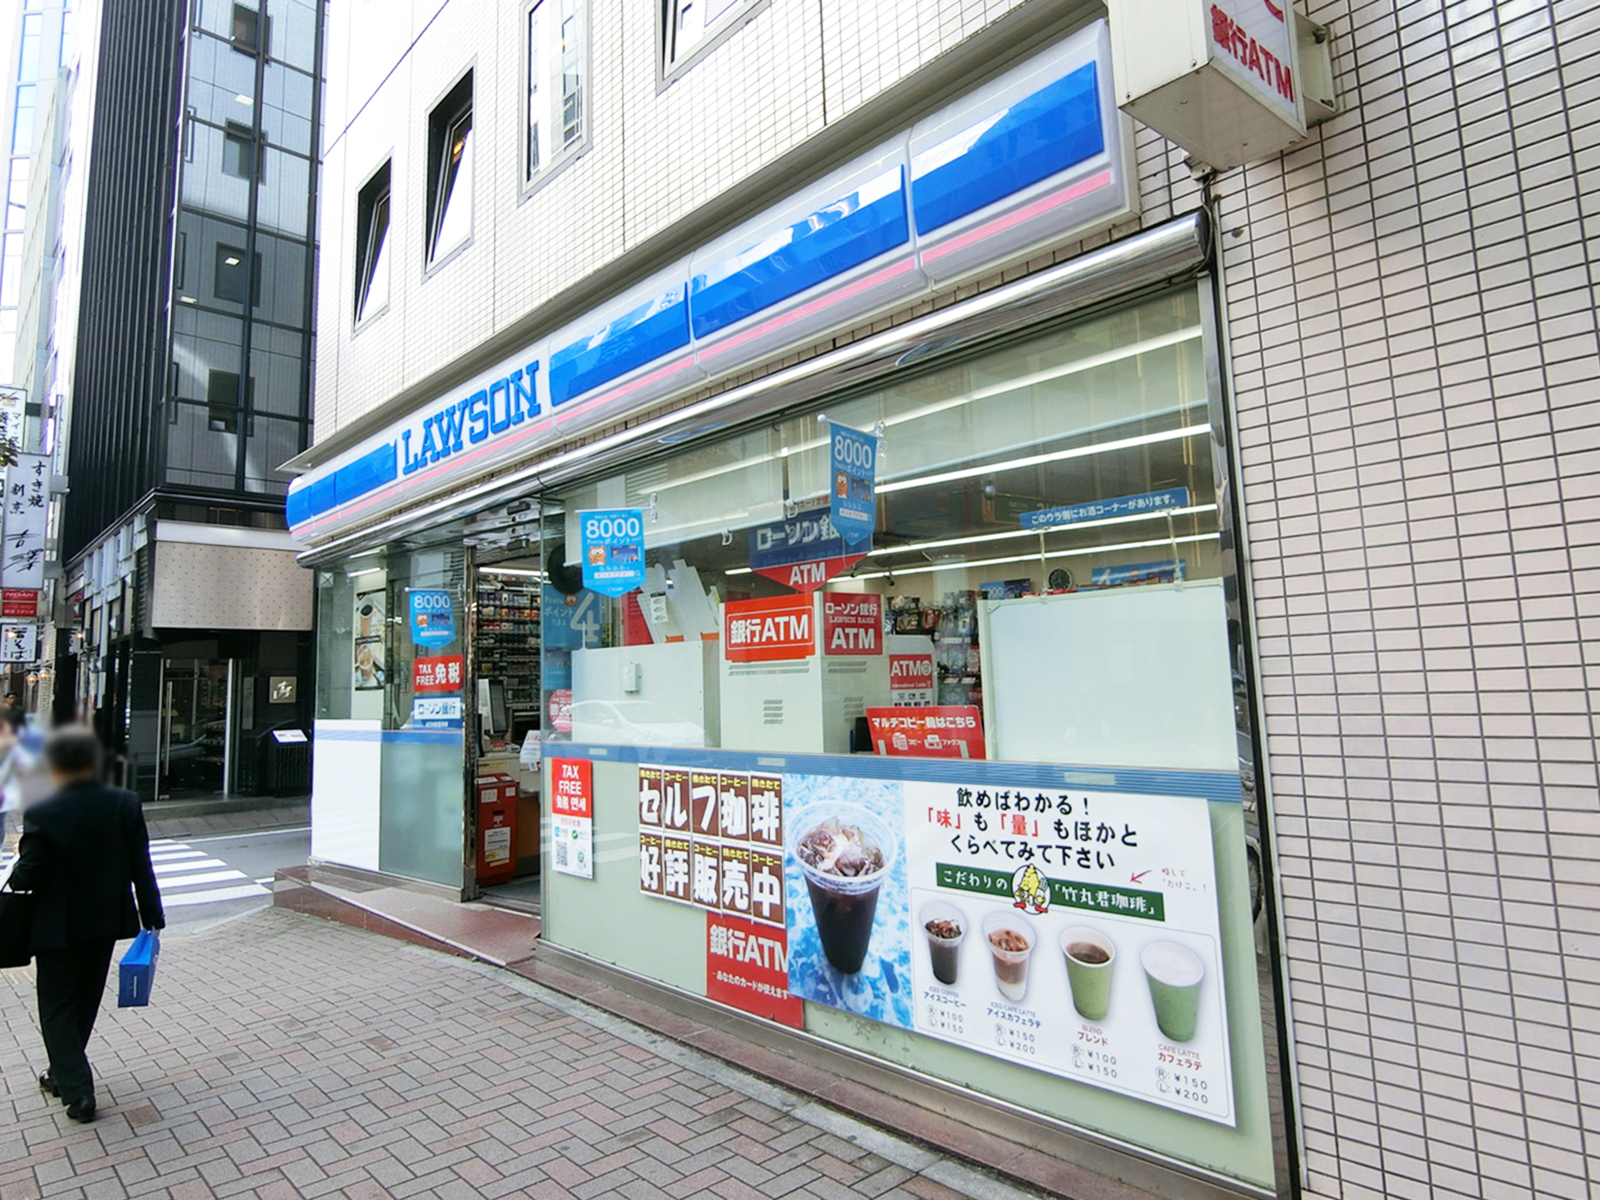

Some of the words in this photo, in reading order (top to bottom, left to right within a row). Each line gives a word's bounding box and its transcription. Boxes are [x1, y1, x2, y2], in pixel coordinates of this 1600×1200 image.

[1210, 3, 1294, 103] 銀行ATM
[402, 360, 541, 475] LAWSON
[834, 435, 872, 469] 8000
[586, 518, 640, 538] 8000
[789, 562, 826, 585] ATM
[414, 595, 450, 608] 8000
[825, 602, 878, 616] ローソン銀行
[730, 614, 809, 644] 銀行ATM
[831, 628, 876, 649] ATM
[418, 664, 433, 674] TAX
[435, 662, 461, 684] 免税
[891, 660, 919, 677] ATM
[416, 675, 434, 686] FREE
[872, 716, 976, 728] マルチコピー機はこちら
[562, 765, 579, 779] TAX
[664, 772, 689, 782] コーヒー
[559, 780, 582, 795] FREE
[720, 777, 747, 787] コーヒー
[640, 778, 780, 841] セルフ珈琲
[957, 787, 1089, 816] 飲めばわかる！
[640, 834, 661, 846] コーヒー
[693, 843, 719, 855] コーヒー
[951, 834, 1115, 870] くらべてみて下さい
[752, 851, 781, 866] コーヒー
[640, 844, 781, 917] 好評販売中
[942, 869, 1008, 891] こだわりの
[923, 991, 966, 1007] アイスコーヒー
[987, 1007, 1041, 1028] アイスカフェラテ
[1082, 1025, 1103, 1035] BLEND
[1158, 1052, 1202, 1070] カフェラテ
